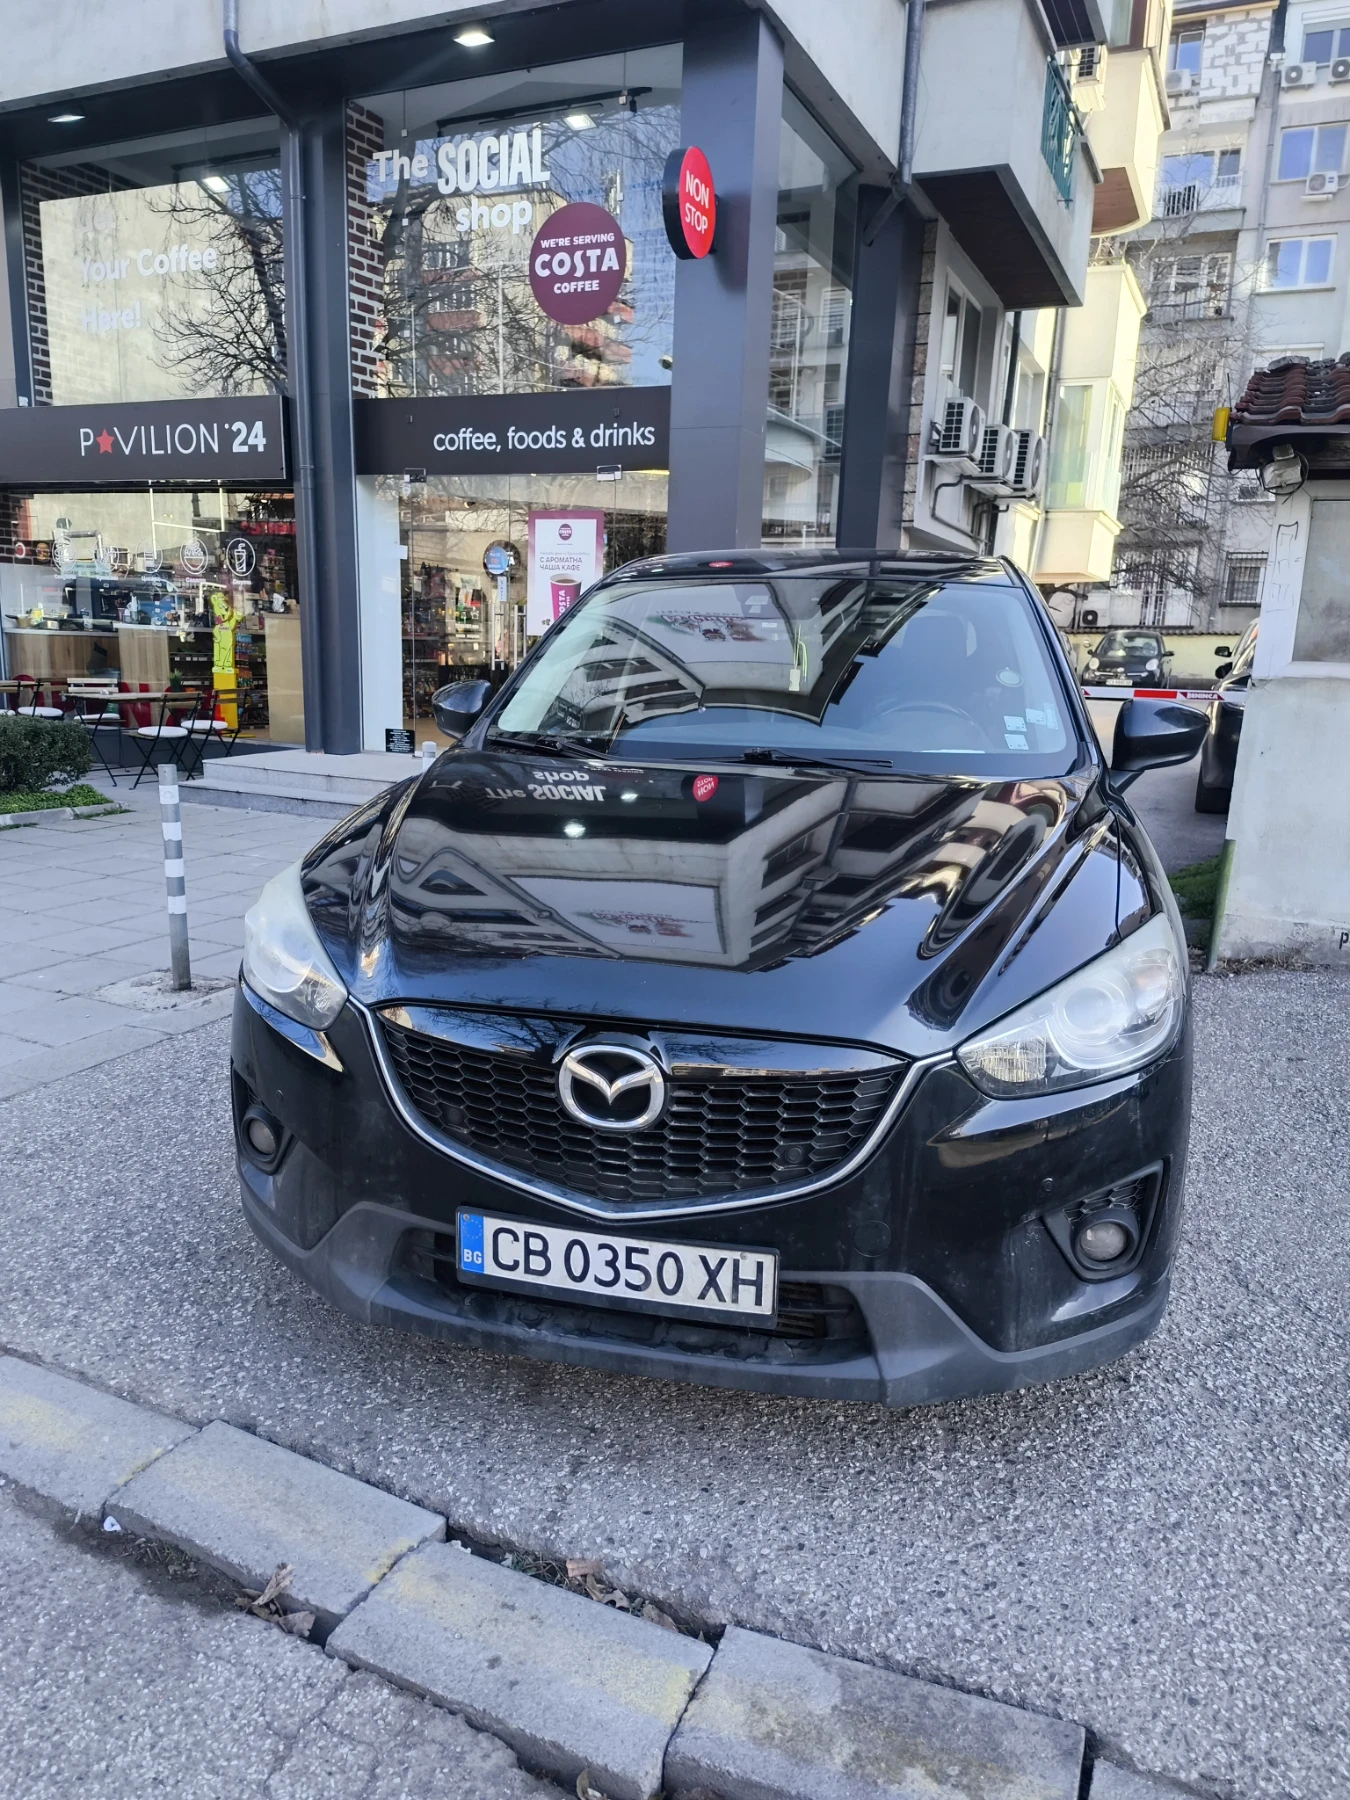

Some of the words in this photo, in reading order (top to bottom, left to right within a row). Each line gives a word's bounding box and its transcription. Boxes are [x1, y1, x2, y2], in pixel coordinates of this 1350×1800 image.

[373, 149, 429, 182] The
[437, 130, 551, 195] SOCIAL
[685, 170, 709, 209] NON
[456, 198, 533, 235] shop
[685, 202, 708, 234] STOP
[540, 237, 571, 248] WE'RE
[573, 233, 615, 245] SERVING
[80, 258, 130, 282] Your
[137, 243, 217, 276] Coffee
[534, 247, 620, 278] COSTA
[553, 280, 600, 294] COFFEE
[81, 301, 142, 332] Here!
[79, 423, 219, 456] PVILION
[433, 427, 502, 452] coffee,
[507, 425, 567, 449] foods
[571, 427, 586, 448] &
[590, 422, 655, 447] drinks
[545, 556, 583, 564] АРОМАТНА
[463, 1248, 483, 1265] BG
[491, 1227, 551, 1277] CB
[563, 1238, 684, 1297] 0350
[697, 1254, 764, 1307] XH
